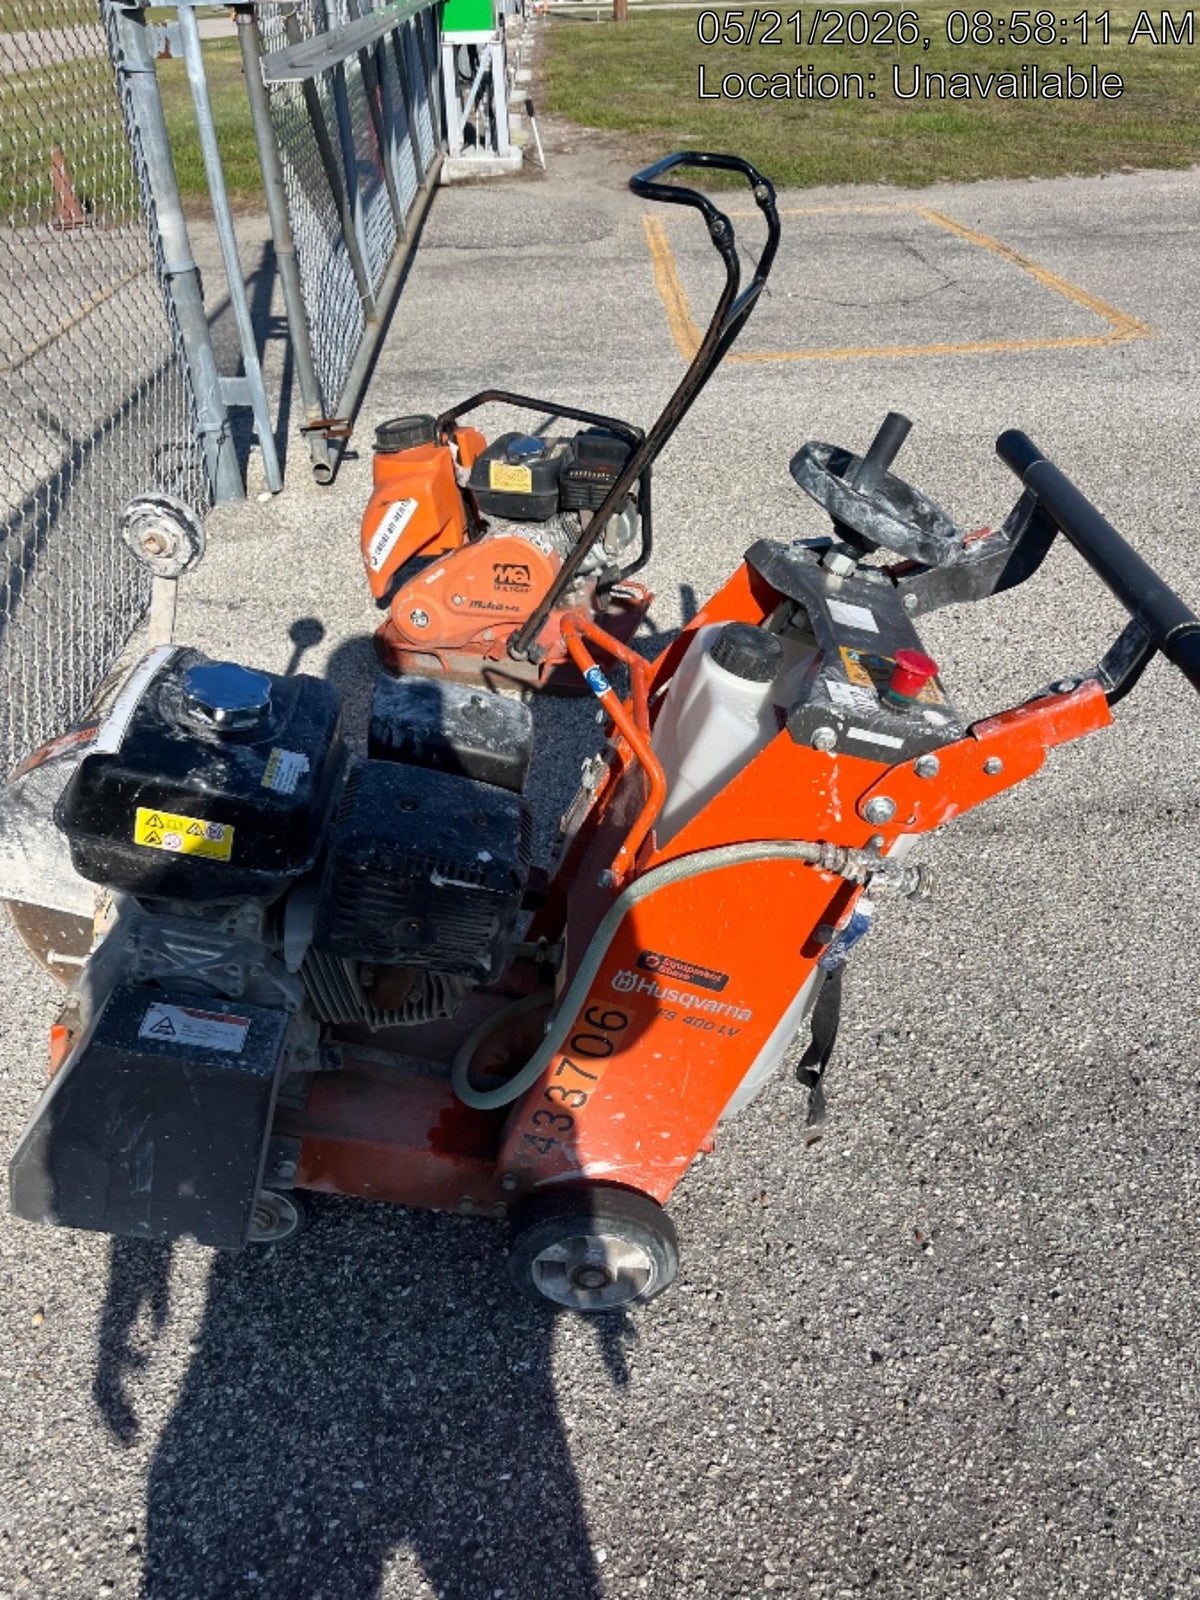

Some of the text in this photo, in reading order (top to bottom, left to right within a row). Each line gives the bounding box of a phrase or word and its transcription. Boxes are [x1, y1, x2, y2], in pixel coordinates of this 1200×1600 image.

[636, 975, 753, 1022] Husqvarna
[683, 1015, 716, 1031] 400
[718, 1025, 741, 1037] LV
[524, 1006, 629, 1154] 433706
